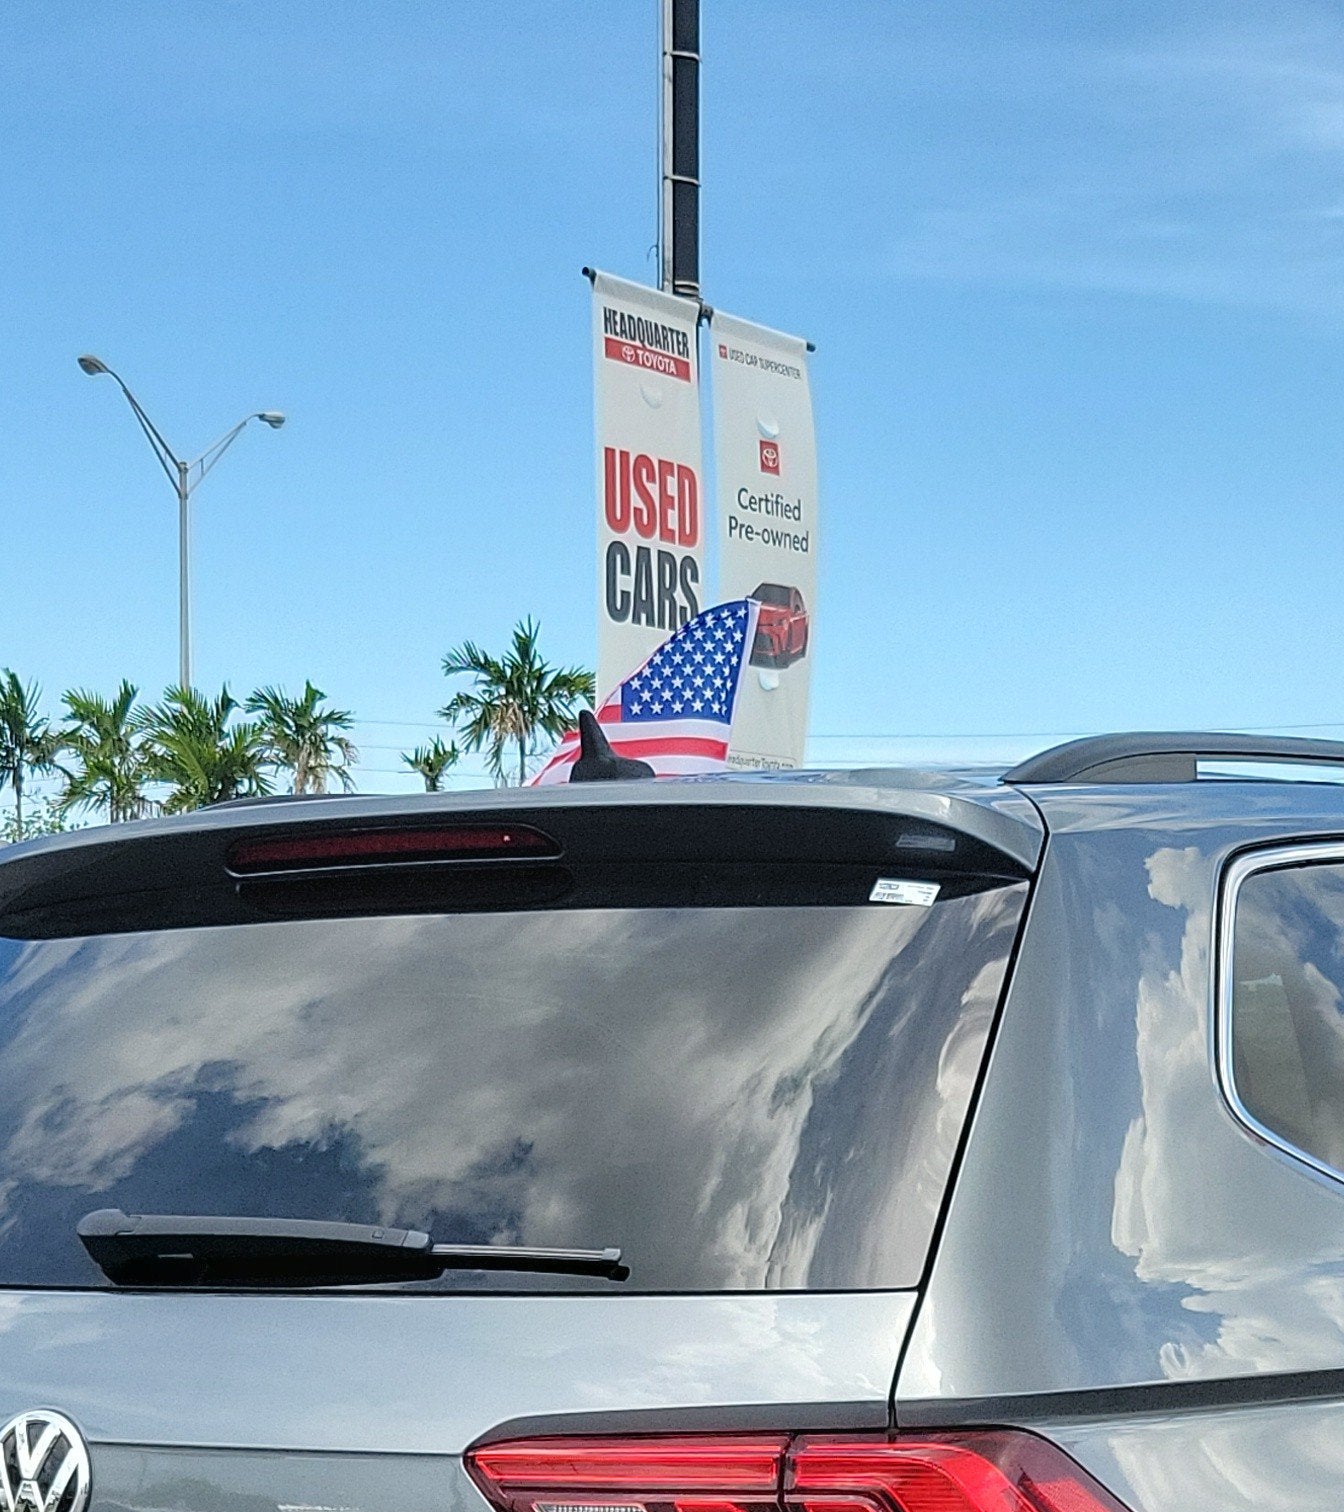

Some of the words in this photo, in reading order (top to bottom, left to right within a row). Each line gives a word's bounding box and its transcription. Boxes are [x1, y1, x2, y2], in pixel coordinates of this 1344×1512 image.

[603, 306, 690, 359] HEADQUARTER
[636, 349, 677, 375] TOYOTA
[604, 446, 698, 548] USED
[737, 487, 802, 522] Certified
[728, 515, 810, 553] Pre-owned
[606, 540, 699, 632] CARS
